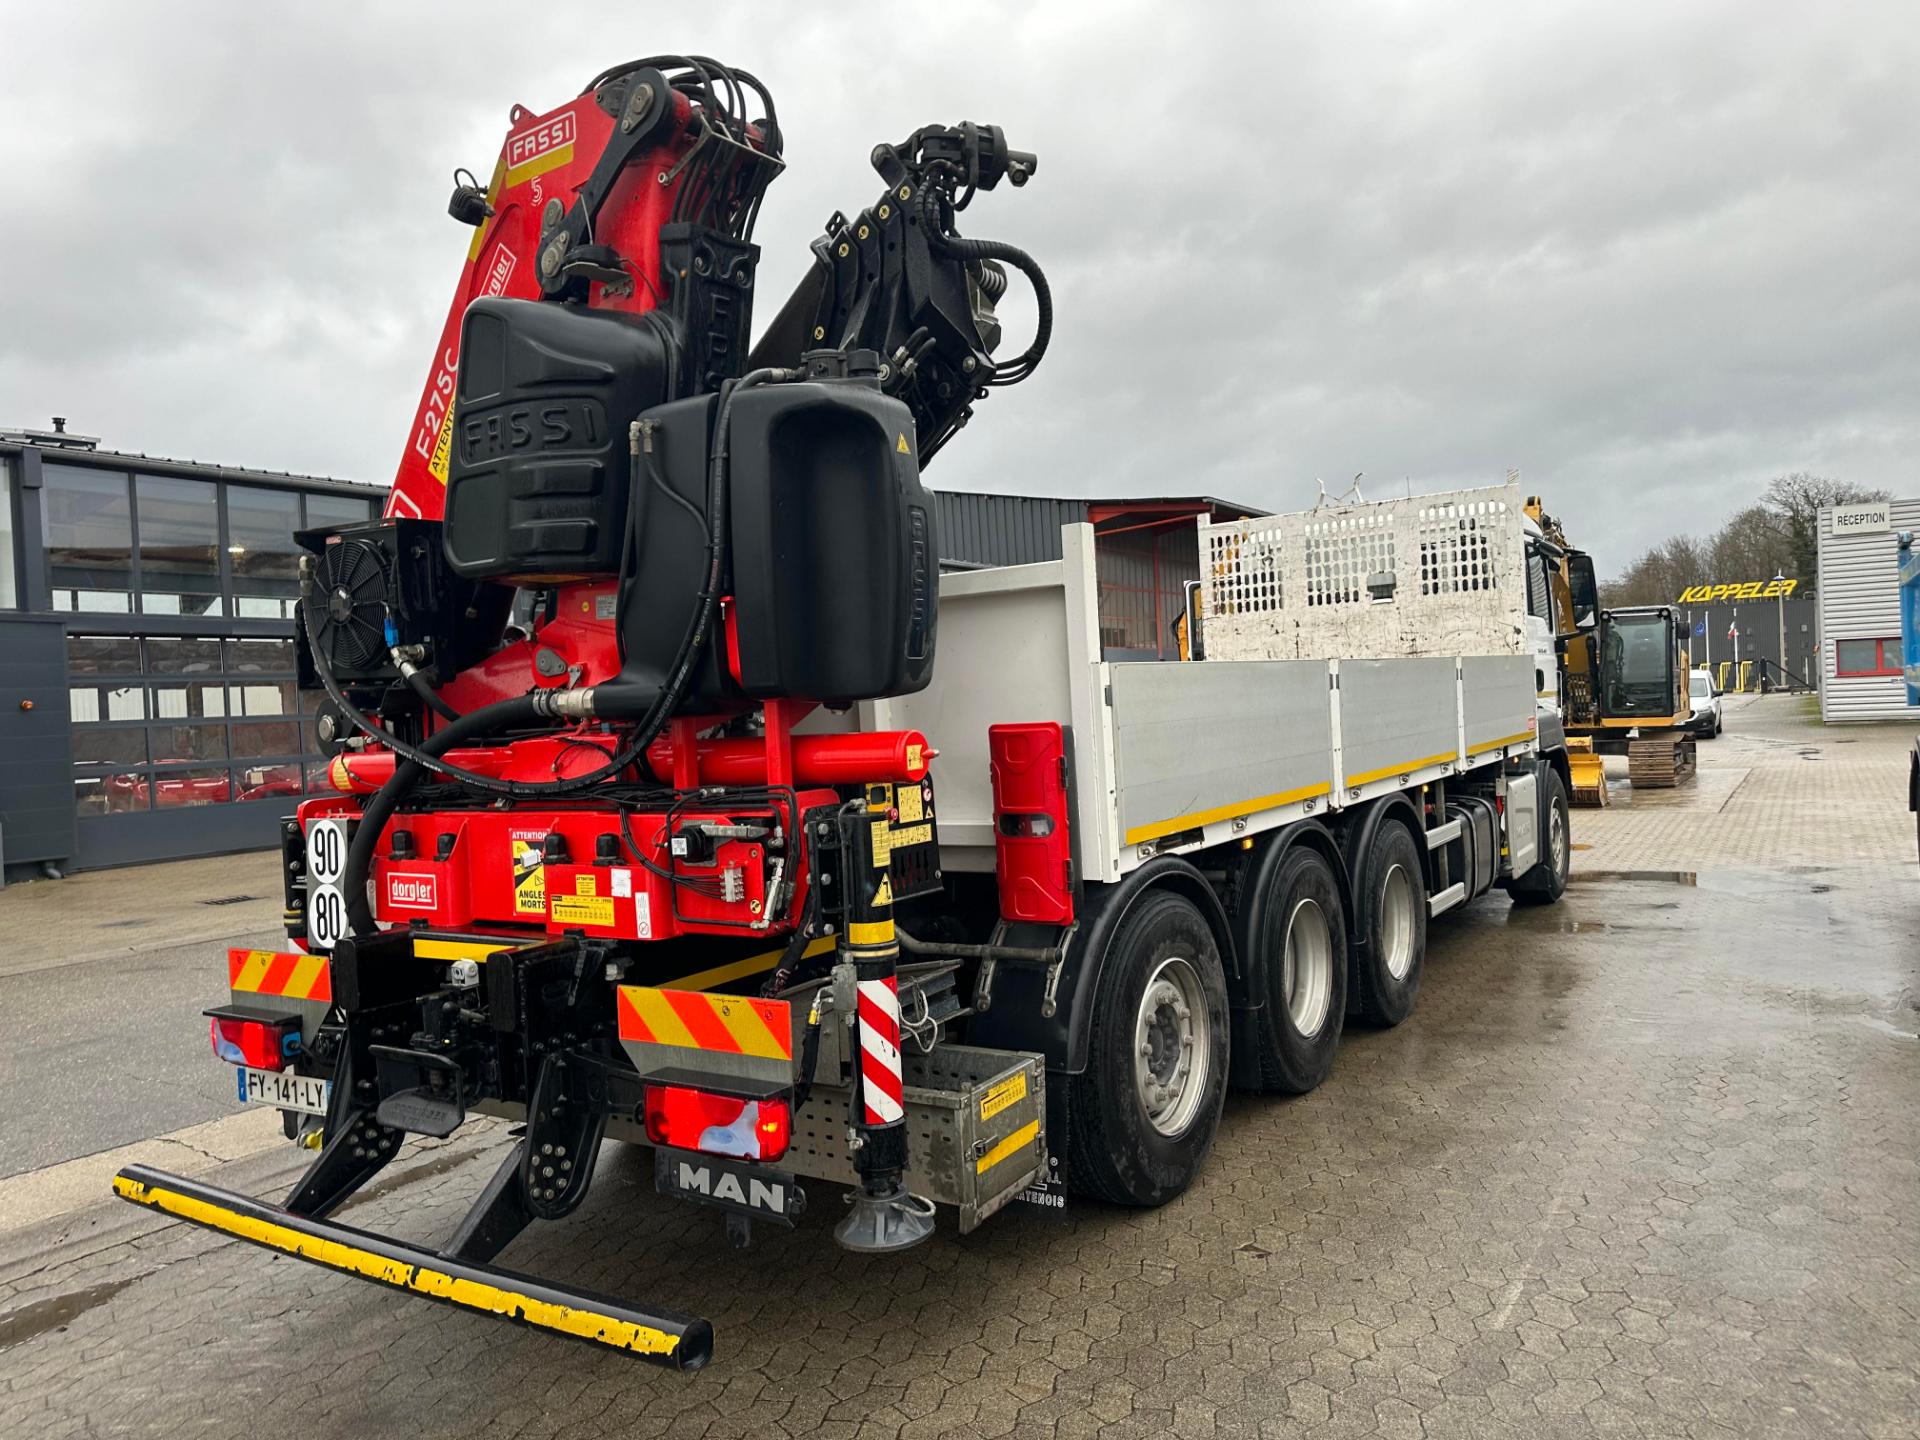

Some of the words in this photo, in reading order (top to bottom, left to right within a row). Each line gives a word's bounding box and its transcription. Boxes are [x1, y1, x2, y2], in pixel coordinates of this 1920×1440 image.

[513, 120, 570, 161] FASSI
[488, 253, 509, 297] rgler
[432, 400, 456, 473] ATTENTI
[466, 403, 598, 458] FASSI
[1837, 511, 1885, 526] RÉCEPTION
[1677, 579, 1798, 603] KAPPELER
[314, 828, 338, 876] 90
[392, 879, 433, 902] dorgler
[520, 900, 546, 910] MORTS
[315, 892, 340, 941] 80
[248, 1072, 323, 1108] FY-141-LY
[679, 1161, 784, 1213] MAN
[1015, 1189, 1065, 1208] ATENOIS
